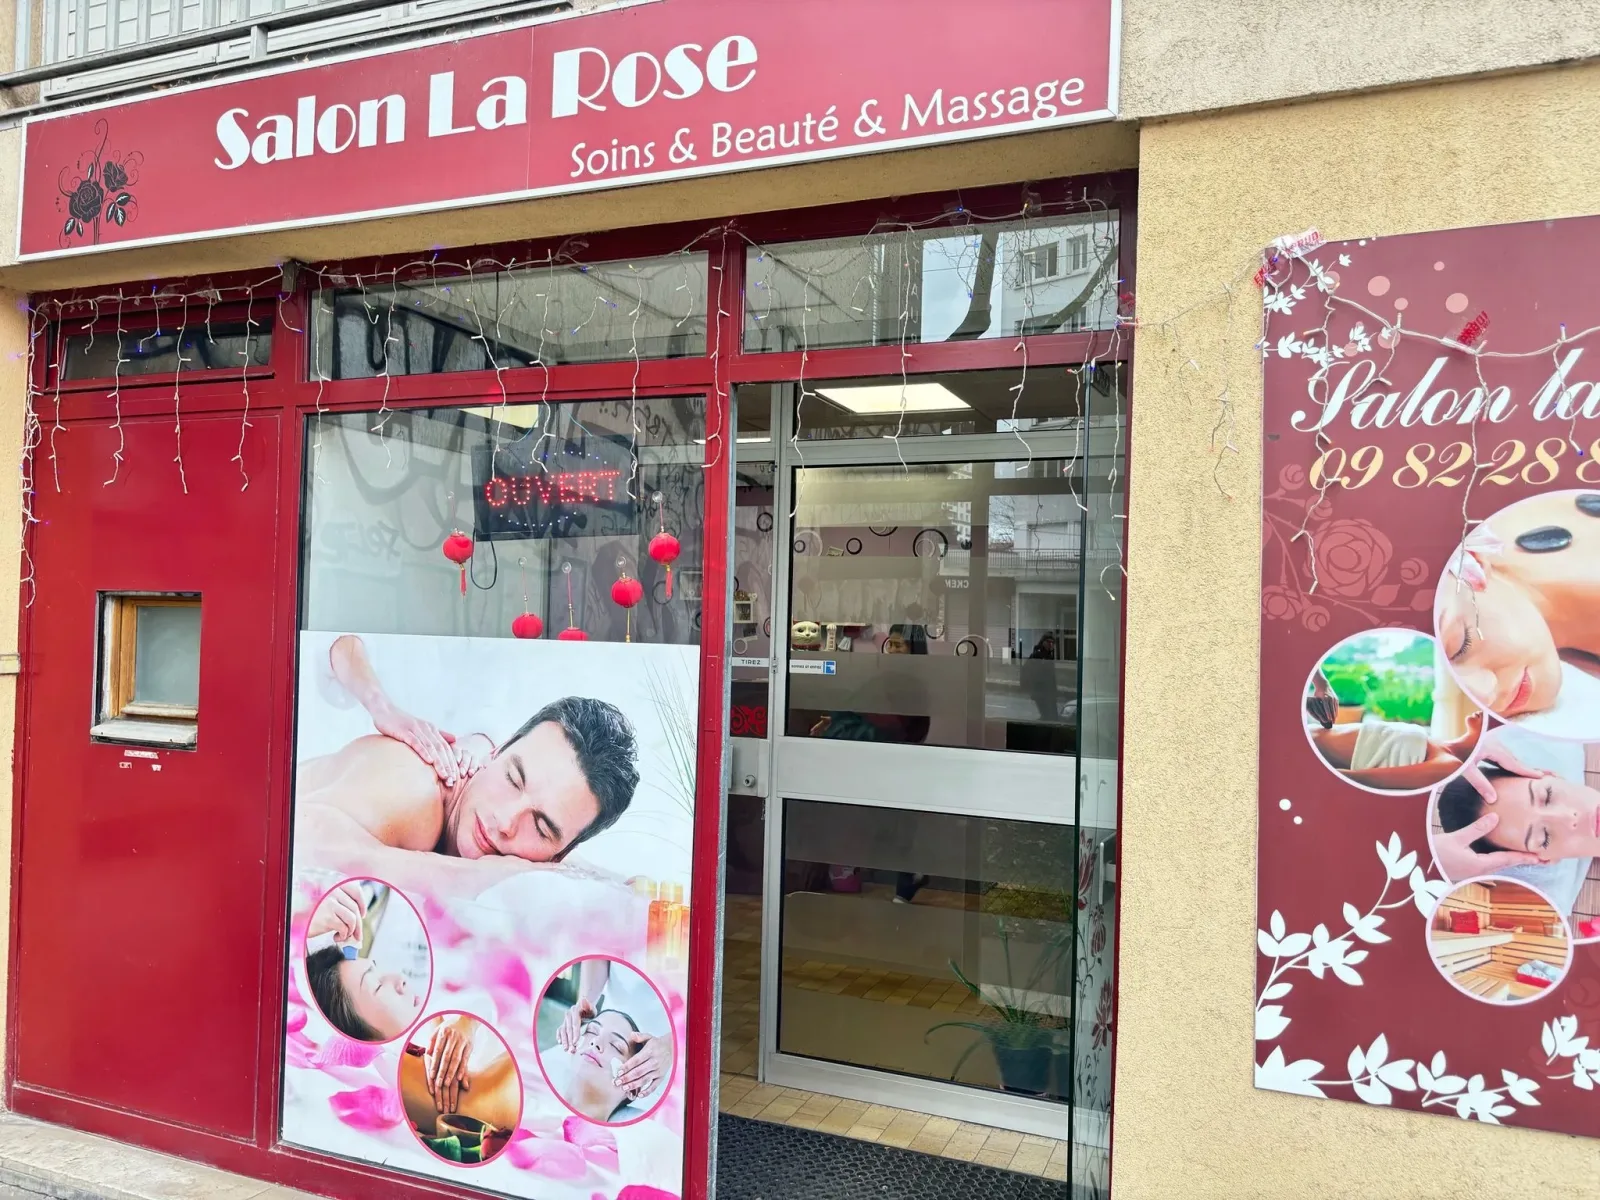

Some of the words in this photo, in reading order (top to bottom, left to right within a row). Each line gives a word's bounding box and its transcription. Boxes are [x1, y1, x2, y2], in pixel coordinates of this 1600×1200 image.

[213, 92, 405, 171] Salon
[427, 70, 528, 138] La
[551, 34, 758, 119] Rose
[569, 138, 655, 178] Soins
[668, 127, 698, 164] &
[711, 105, 838, 157] Beauté
[852, 98, 886, 138] &
[901, 77, 1086, 132] Massage
[1290, 356, 1518, 432] Salon
[484, 470, 621, 507] OUVERT
[1309, 445, 1384, 490] 09
[1392, 441, 1476, 489] 82
[1478, 437, 1567, 486] 28
